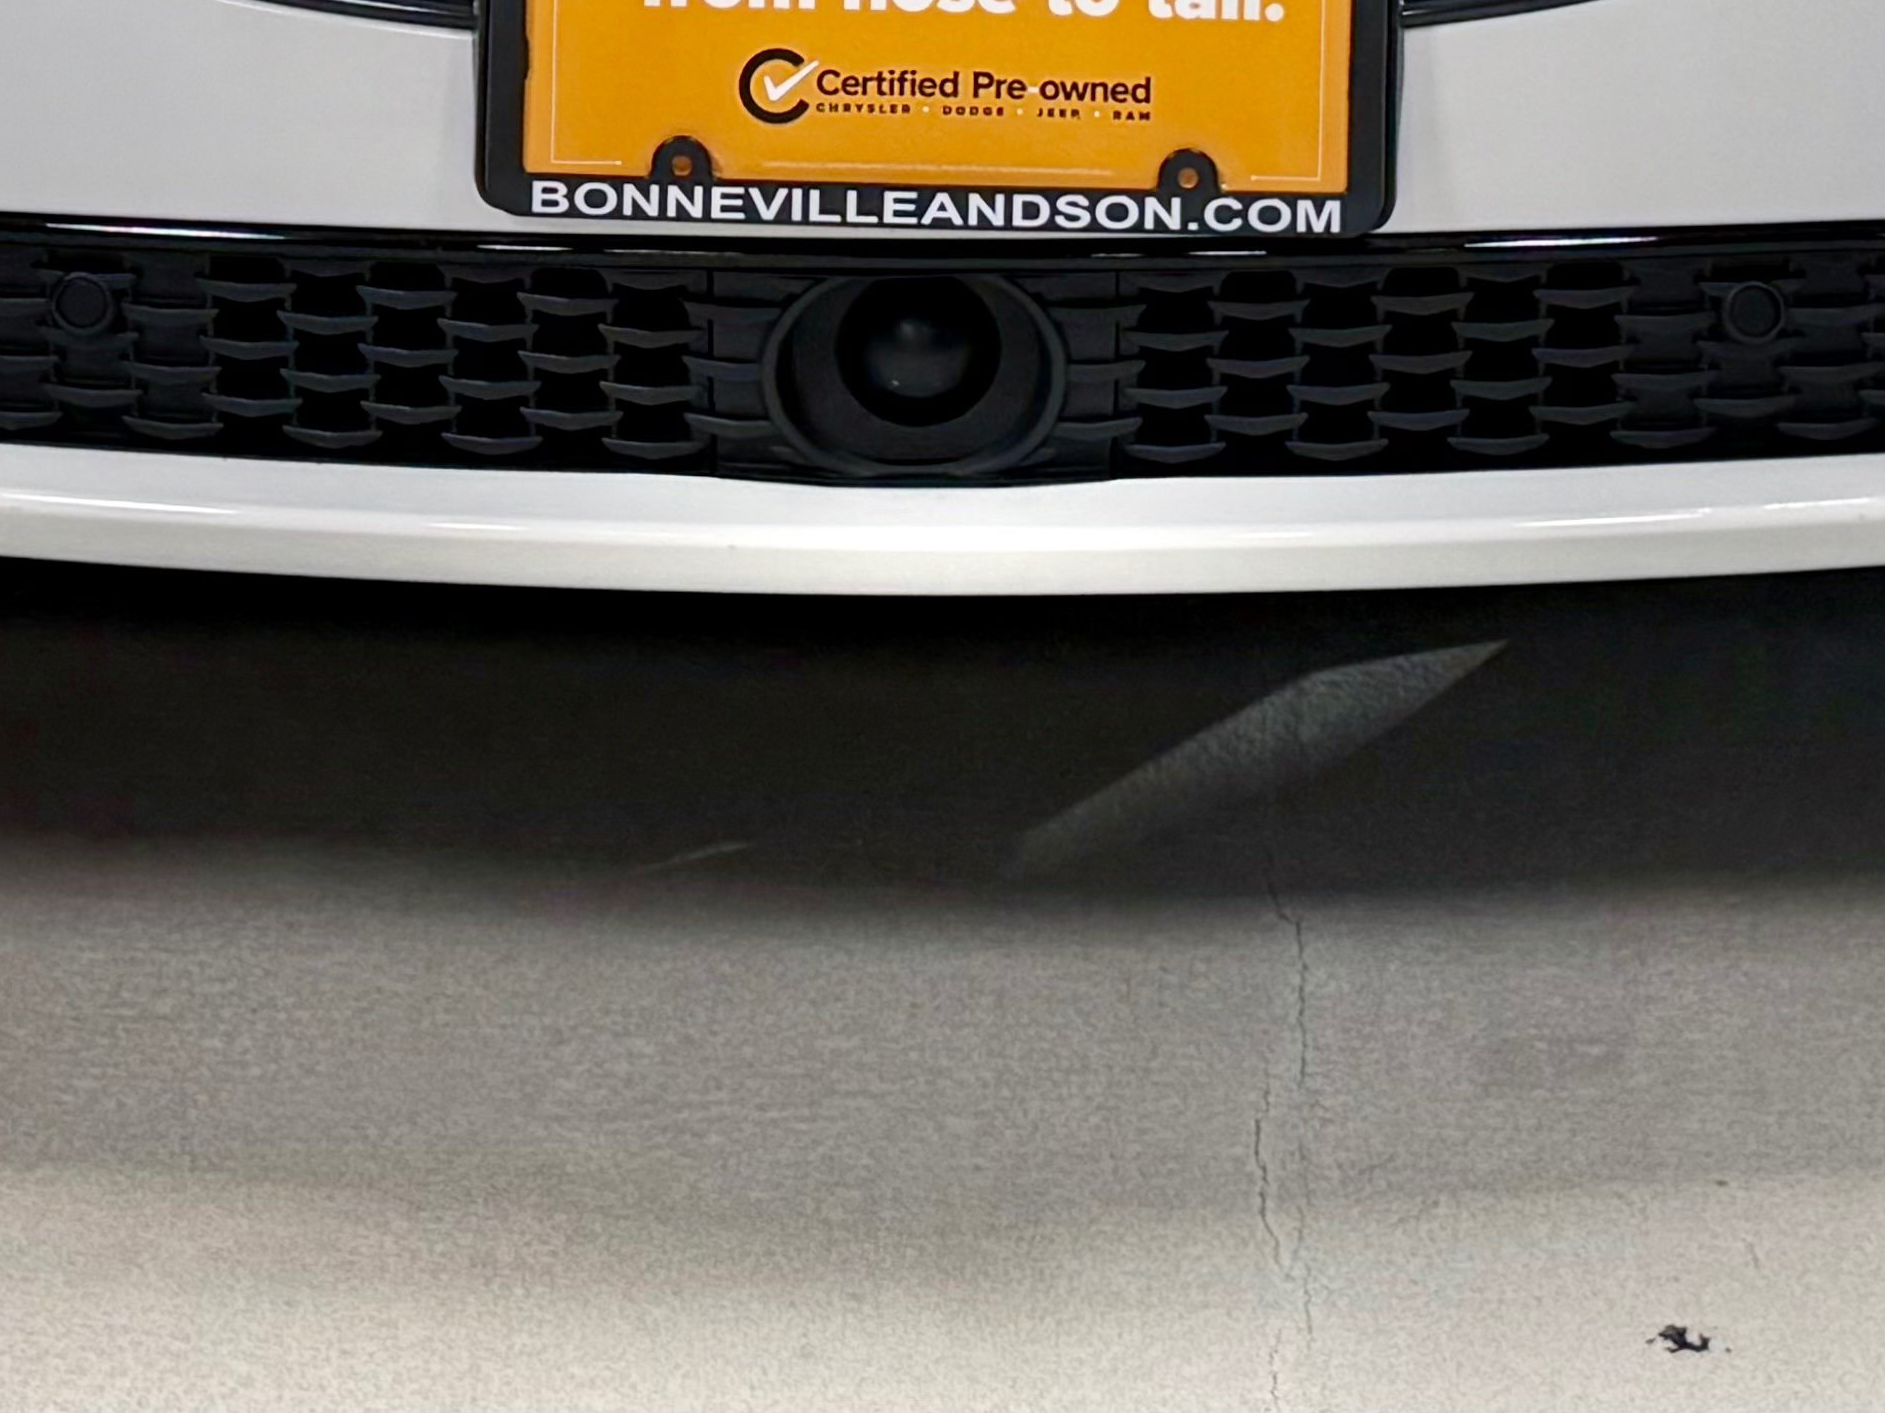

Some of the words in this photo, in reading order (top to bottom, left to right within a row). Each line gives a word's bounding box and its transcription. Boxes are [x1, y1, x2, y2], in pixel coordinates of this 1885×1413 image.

[816, 69, 960, 98] Certified
[815, 101, 912, 114] CHRYSLER
[942, 105, 1005, 117] DODGE
[1112, 110, 1152, 121] RAM
[529, 179, 1343, 235] BONNEVILLEANDSON.COM
